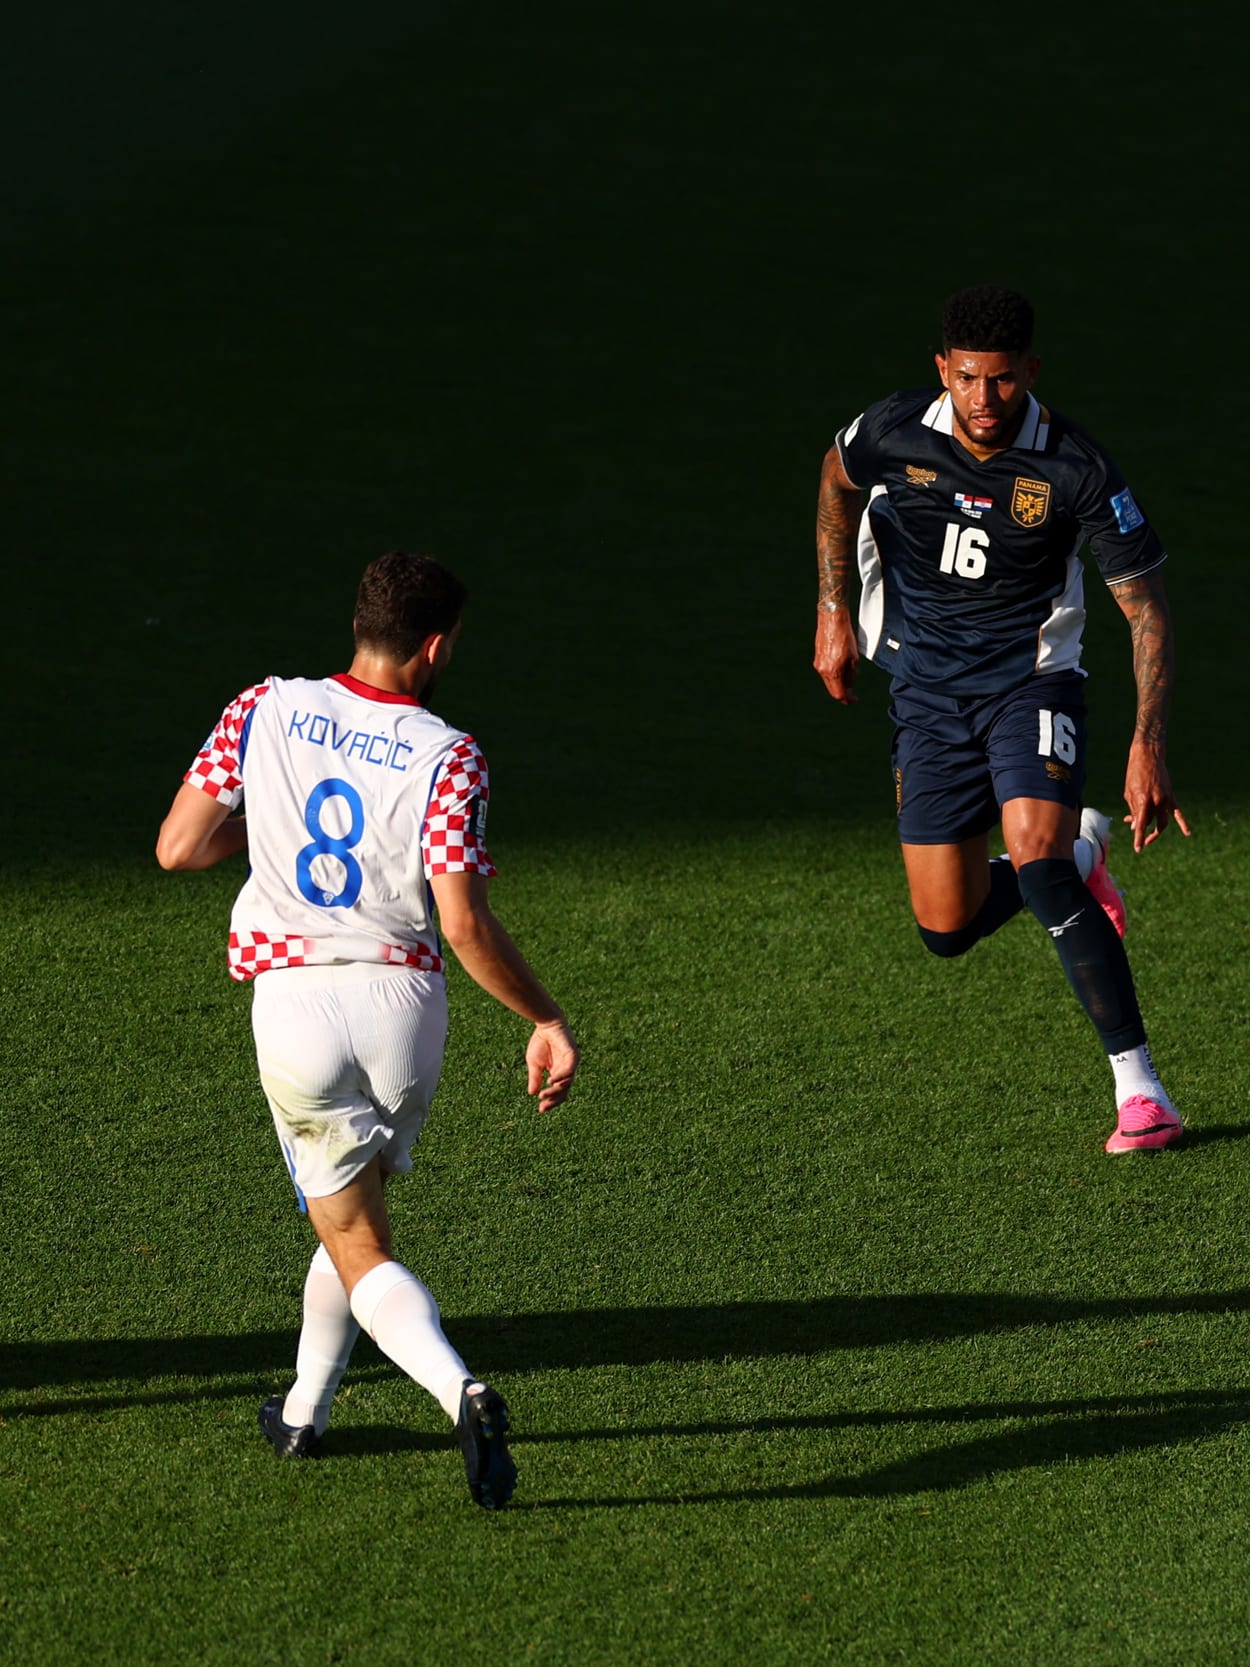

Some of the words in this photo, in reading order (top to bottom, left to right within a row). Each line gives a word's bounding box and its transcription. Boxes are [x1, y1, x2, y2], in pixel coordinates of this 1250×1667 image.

[1018, 480, 1047, 492] PANAMA
[939, 522, 990, 580] 16
[1037, 708, 1077, 766] 16
[295, 777, 365, 909] 8
